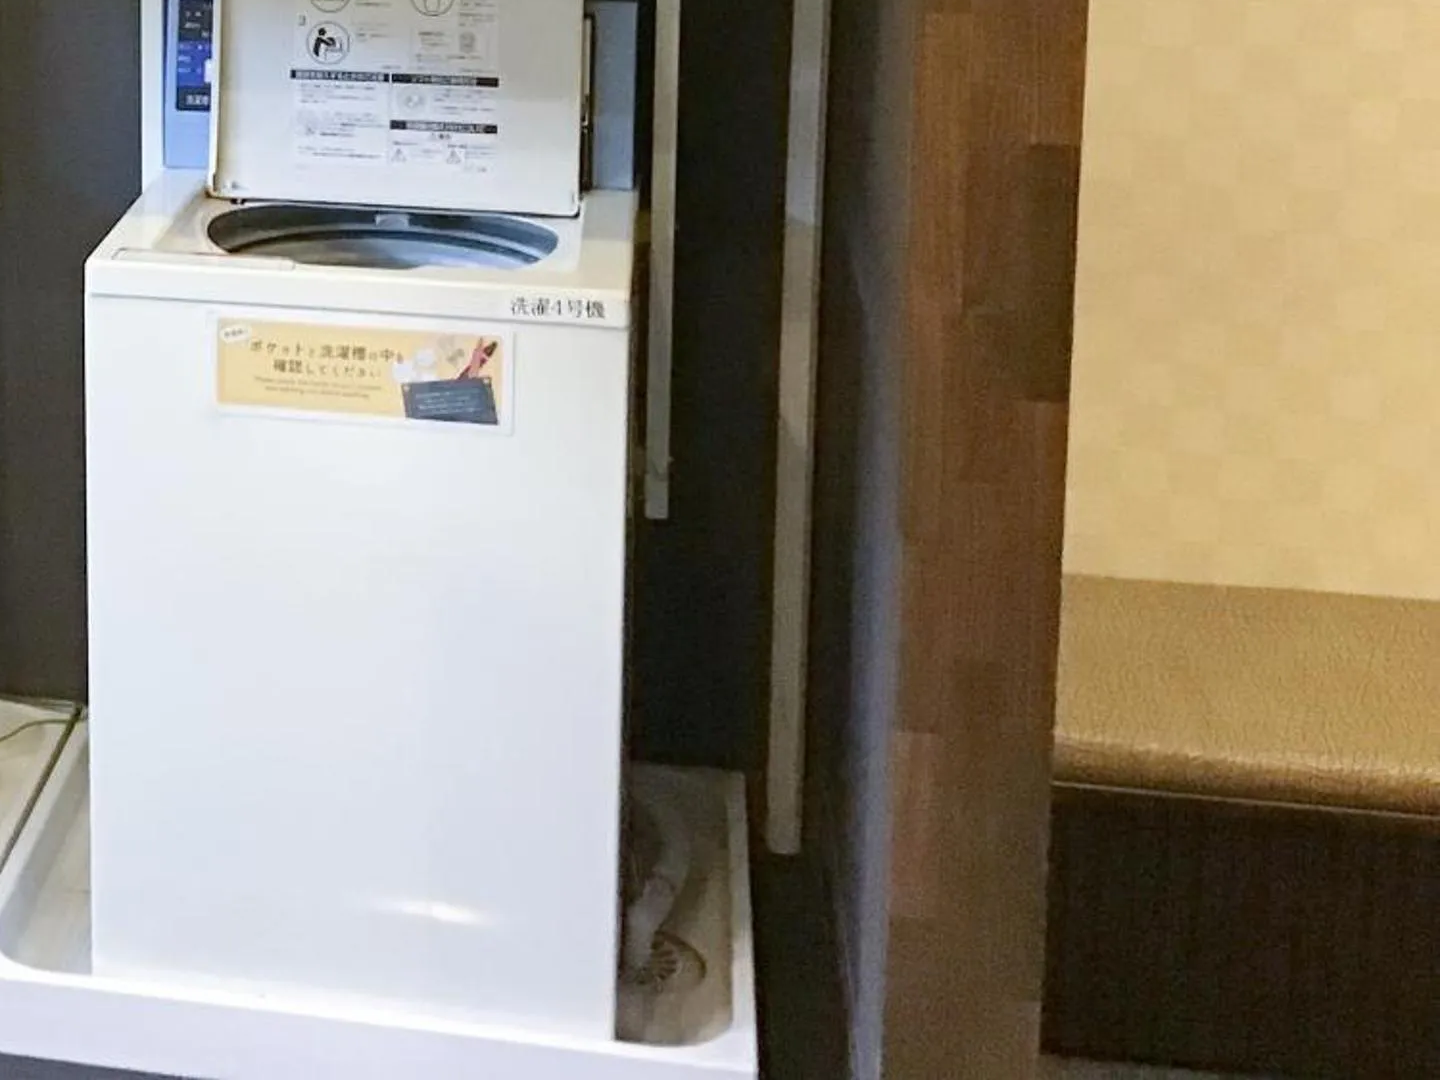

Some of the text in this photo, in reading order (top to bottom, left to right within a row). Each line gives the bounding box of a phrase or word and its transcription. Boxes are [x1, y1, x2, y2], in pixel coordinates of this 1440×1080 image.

[509, 296, 607, 319] 洗濯4号機
[272, 358, 382, 378] 確認してください
